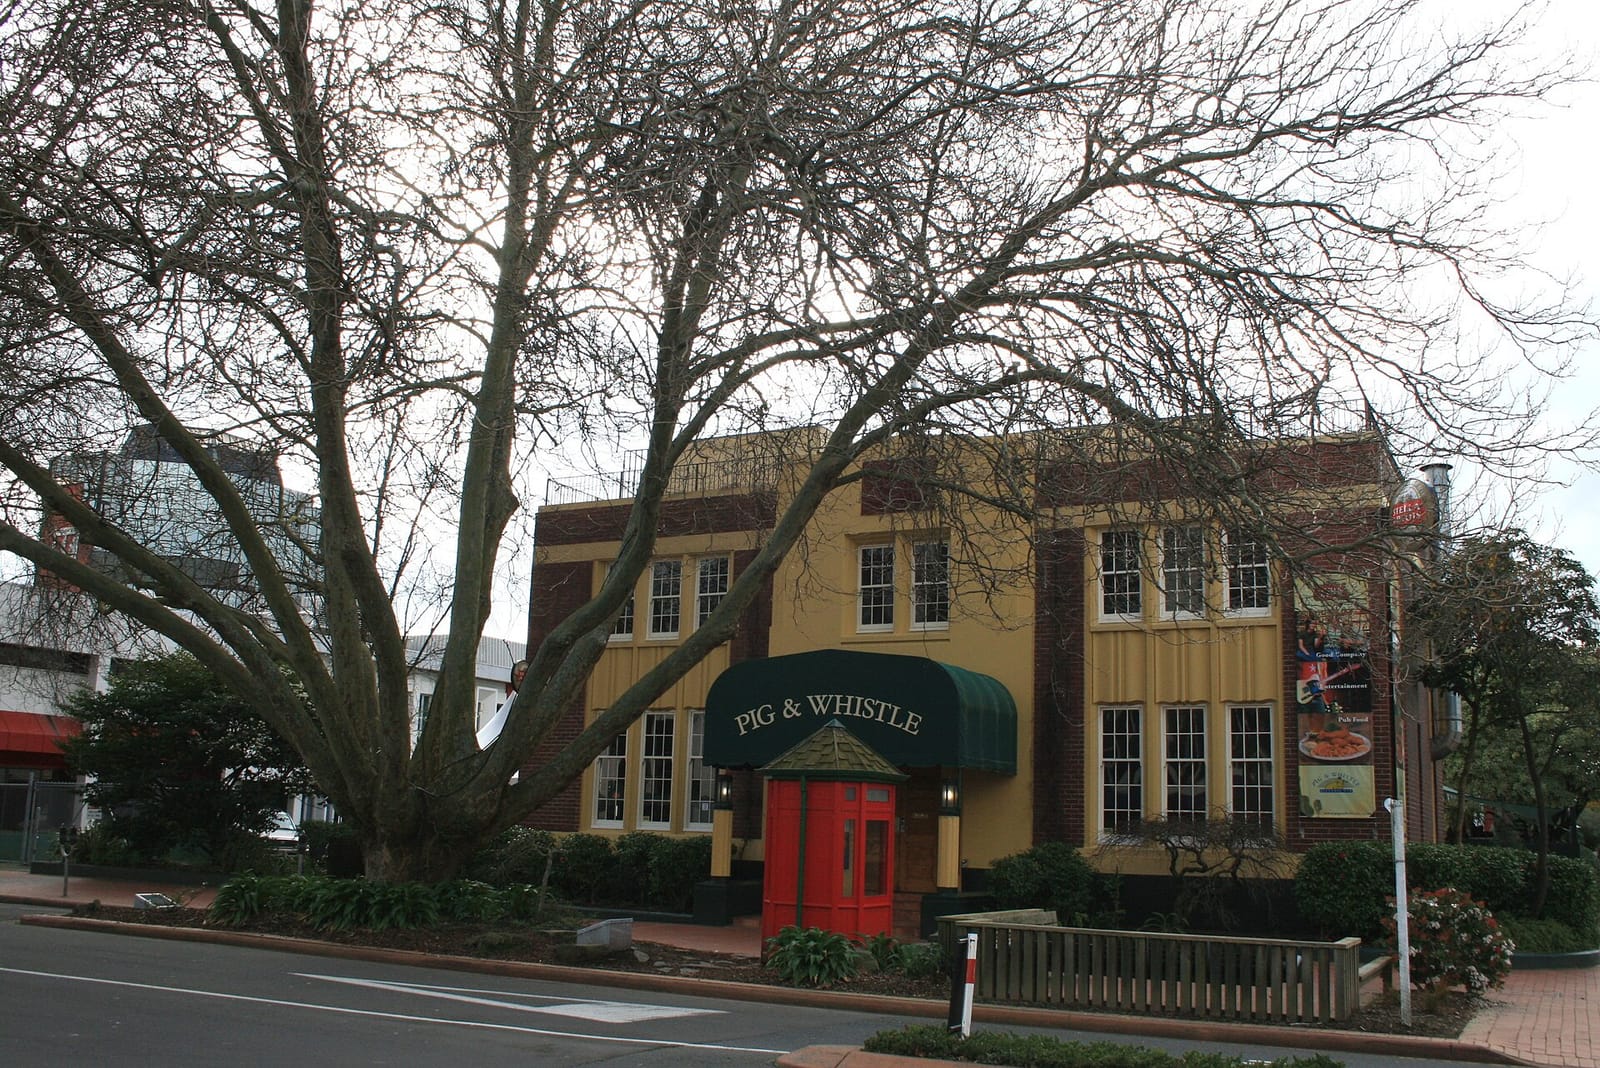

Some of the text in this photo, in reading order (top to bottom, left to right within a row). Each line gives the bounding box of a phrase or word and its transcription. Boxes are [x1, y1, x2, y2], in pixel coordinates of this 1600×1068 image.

[734, 694, 923, 736] PIG & WHISTLE
